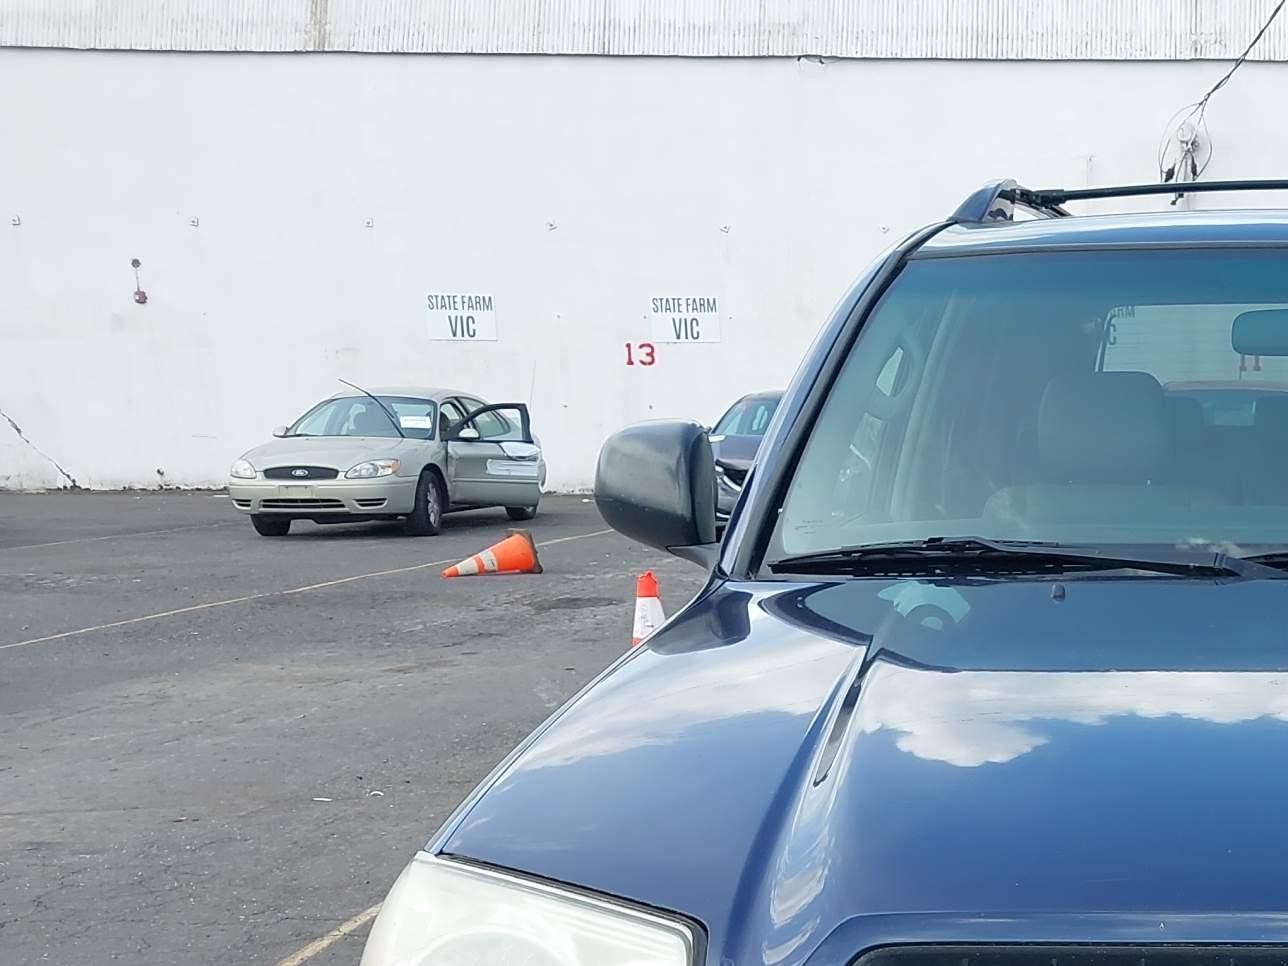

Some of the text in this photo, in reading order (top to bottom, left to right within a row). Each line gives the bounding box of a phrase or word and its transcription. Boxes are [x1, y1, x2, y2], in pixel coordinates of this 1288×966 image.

[427, 295, 493, 311] STATE FARM
[651, 297, 717, 313] STATE FARM
[448, 315, 477, 338] VIC
[672, 317, 700, 340] VIC
[625, 343, 656, 366] 13
